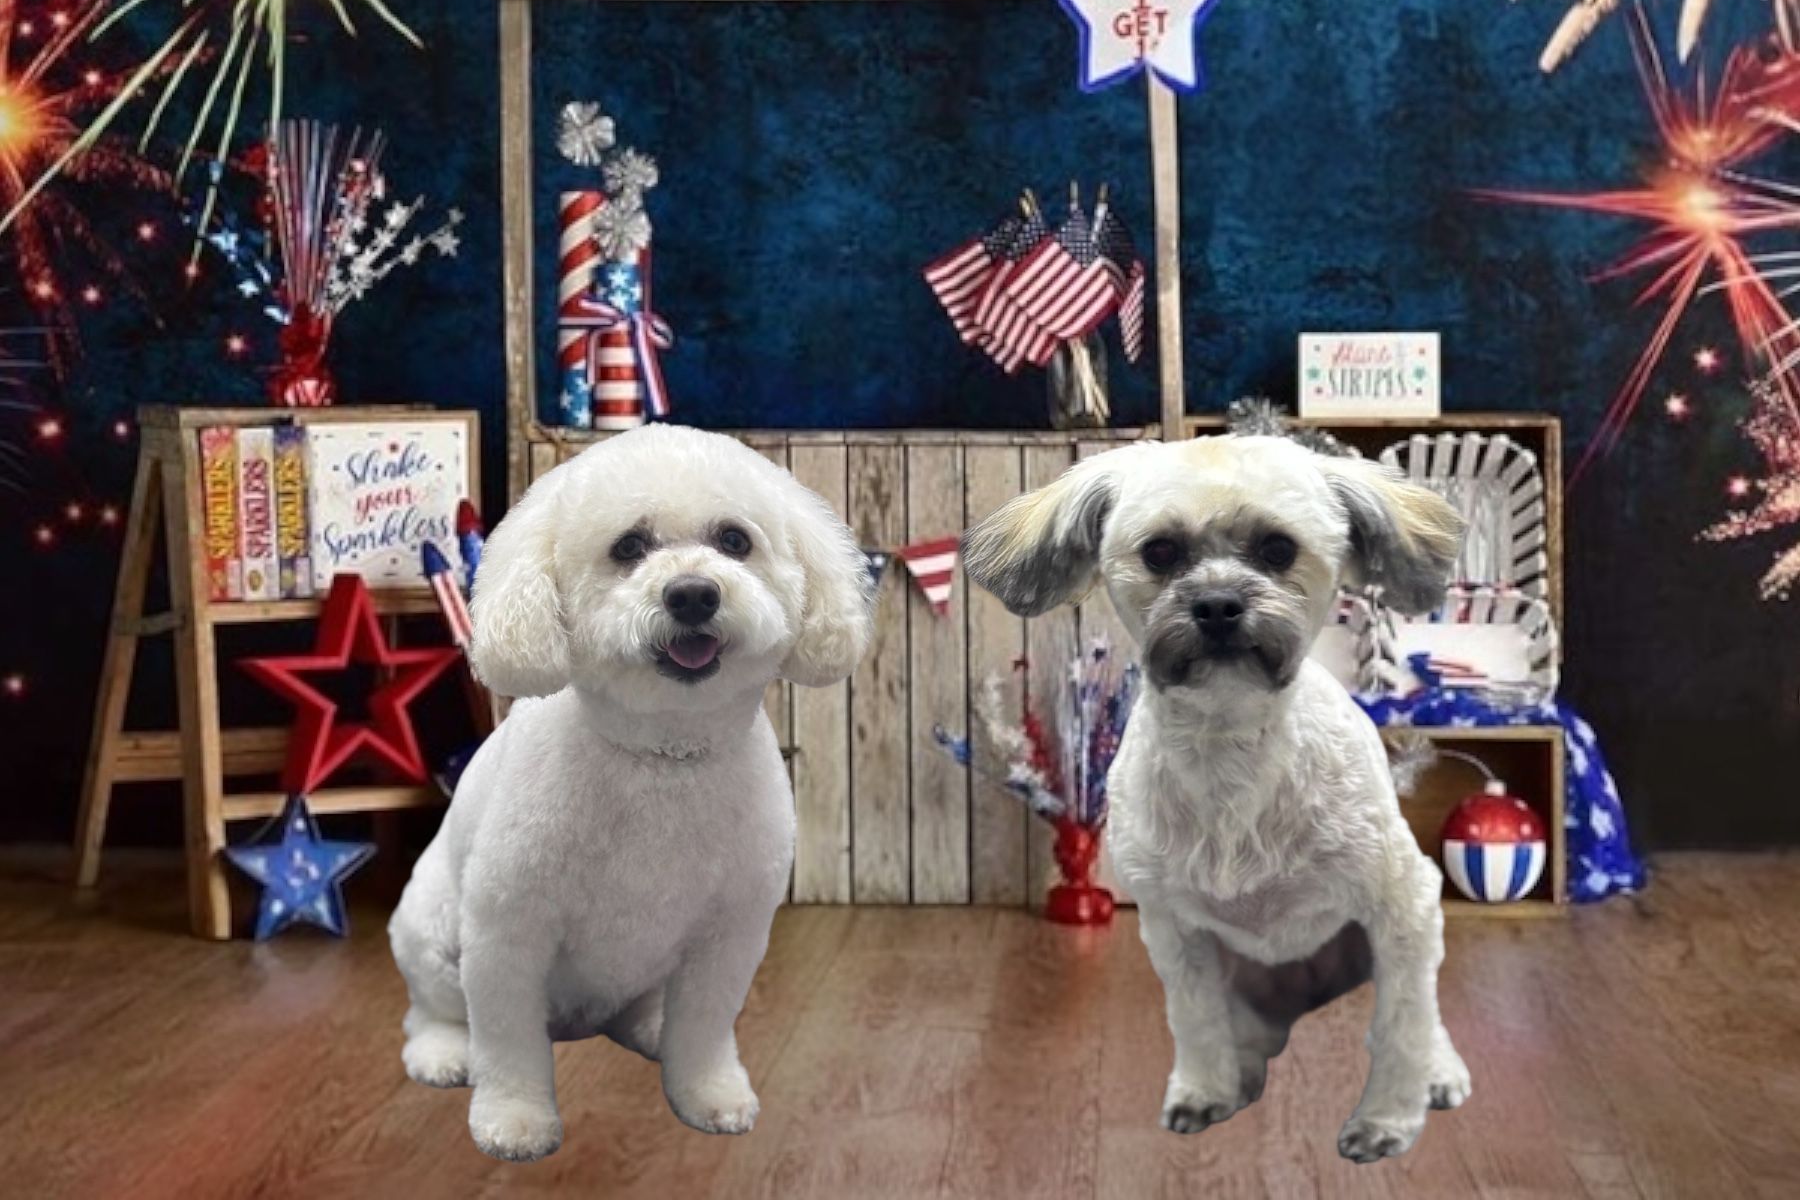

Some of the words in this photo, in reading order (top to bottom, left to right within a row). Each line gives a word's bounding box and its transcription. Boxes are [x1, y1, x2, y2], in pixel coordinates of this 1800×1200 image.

[1112, 9, 1169, 38] GET
[347, 440, 435, 487] Shake
[355, 485, 415, 524] your
